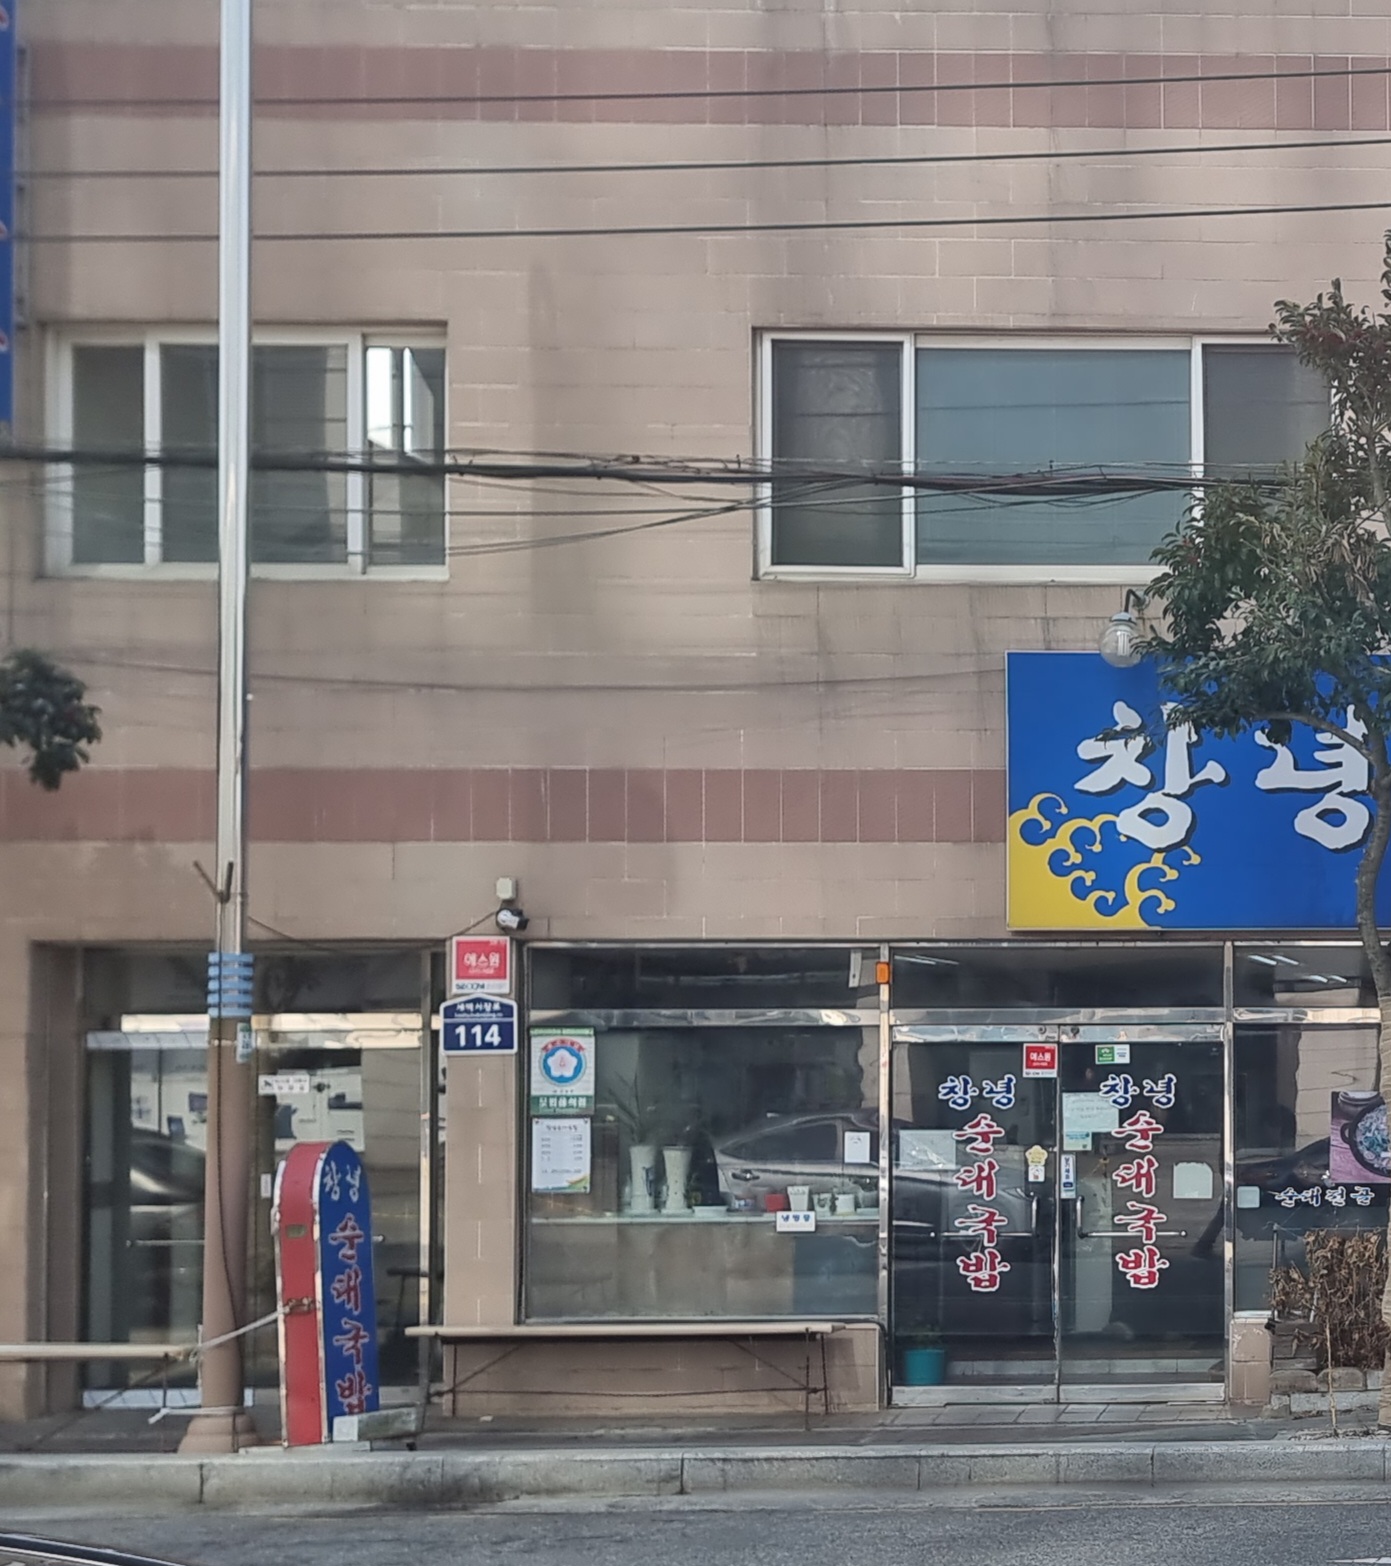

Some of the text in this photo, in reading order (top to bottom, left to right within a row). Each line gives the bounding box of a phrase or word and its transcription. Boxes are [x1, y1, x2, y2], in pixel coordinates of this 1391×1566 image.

[1074, 699, 1370, 851] 창녕
[455, 1024, 502, 1048] 114
[938, 1074, 1016, 1109] 창녕
[1099, 1074, 1177, 1109] 창녕
[952, 1112, 1012, 1293] 순대국밥
[1111, 1110, 1171, 1290] 순대국밥
